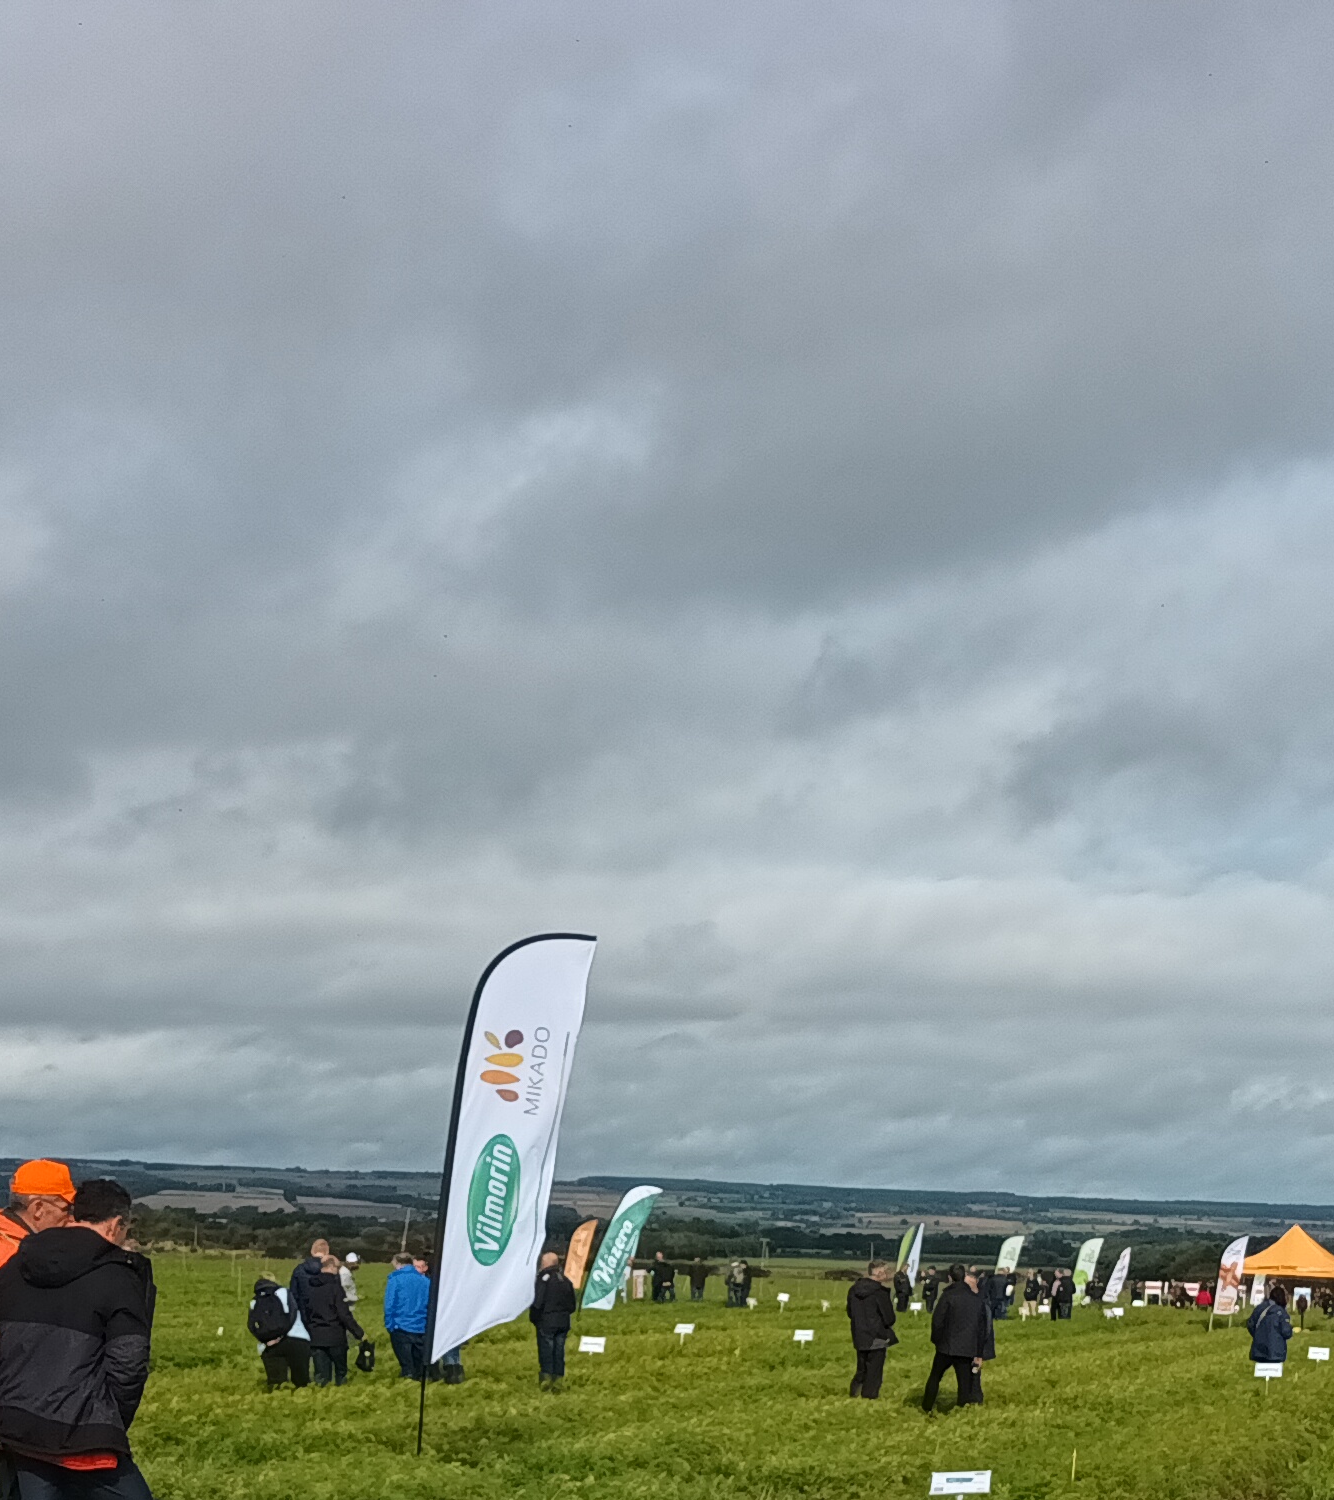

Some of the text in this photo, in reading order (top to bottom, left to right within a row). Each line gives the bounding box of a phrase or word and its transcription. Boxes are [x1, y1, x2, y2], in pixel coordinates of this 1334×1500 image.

[524, 1026, 551, 1116] MIKADO
[474, 1143, 513, 1252] Vilmorin
[592, 1219, 634, 1284] Hazera
